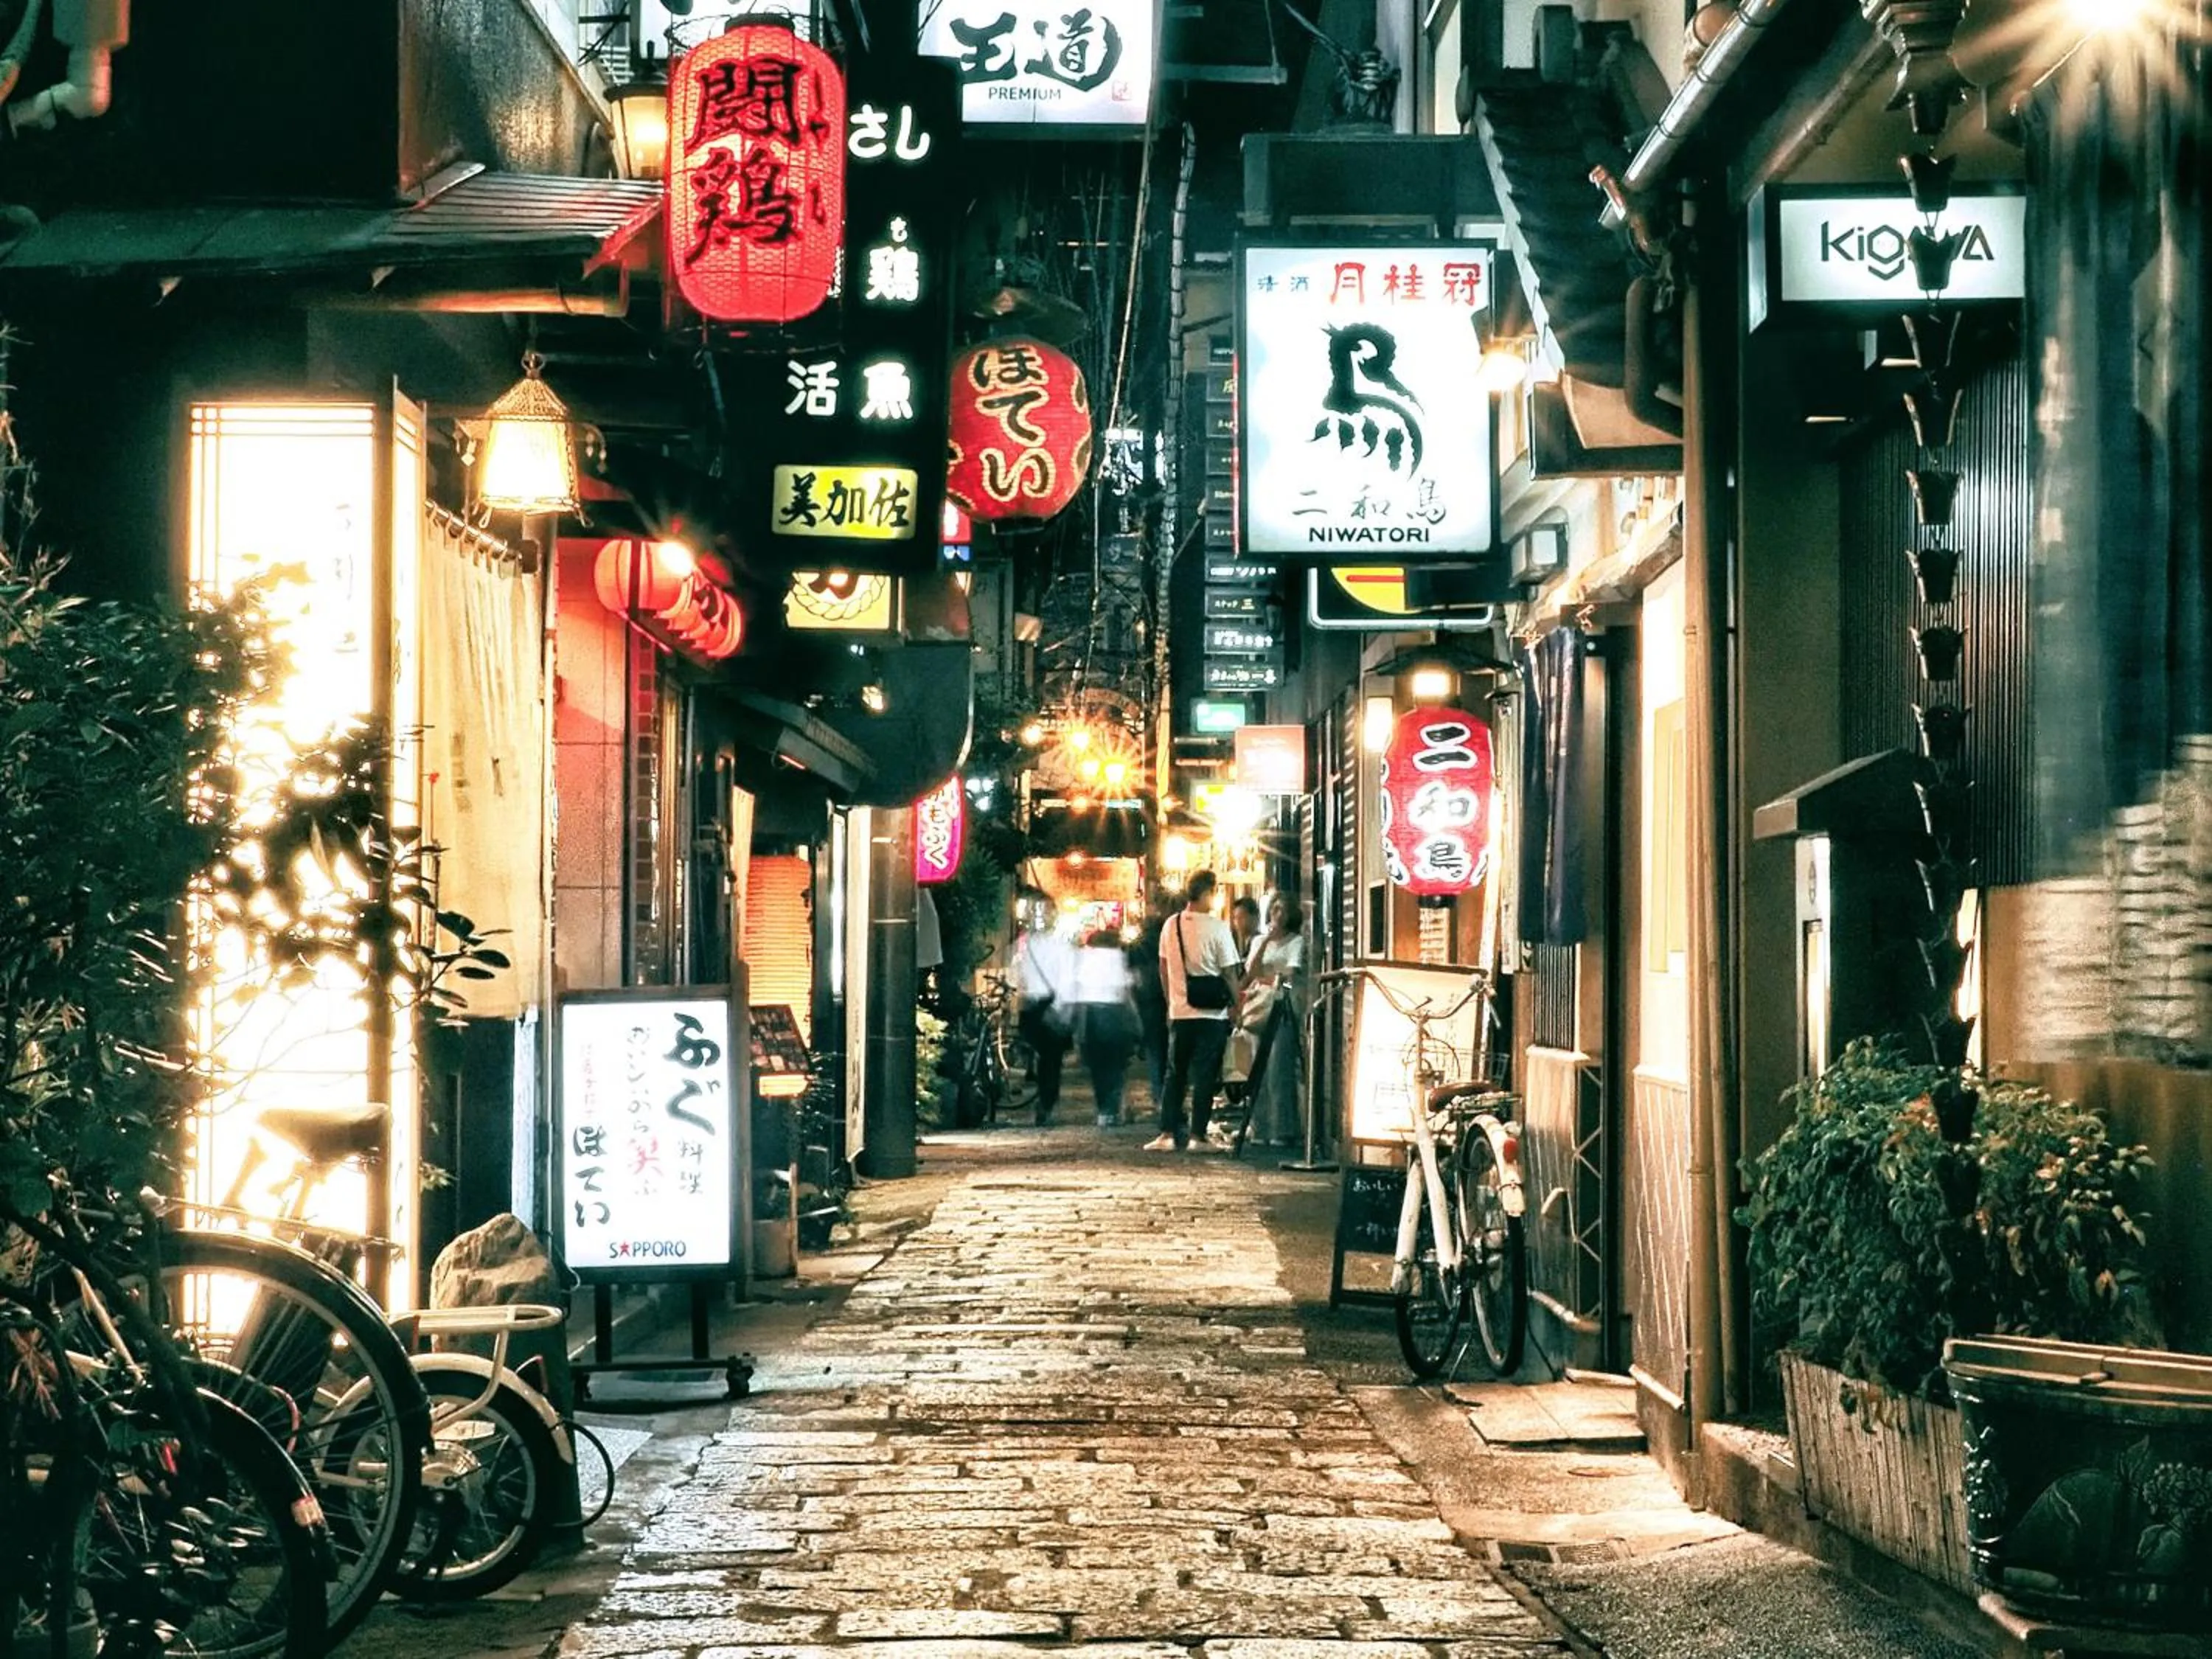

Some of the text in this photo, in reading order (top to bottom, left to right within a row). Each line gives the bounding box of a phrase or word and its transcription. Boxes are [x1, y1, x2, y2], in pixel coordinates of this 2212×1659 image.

[949, 7, 1123, 92] 王道
[988, 86, 1062, 100] PREMIUM
[1256, 261, 1482, 307] 清酒 月桂冠
[785, 358, 914, 420] 活魚
[969, 347, 1056, 501] ほてい
[778, 472, 911, 528] 美加佐
[1308, 526, 1430, 543] NIWATORI
[572, 1124, 611, 1228] ほてい
